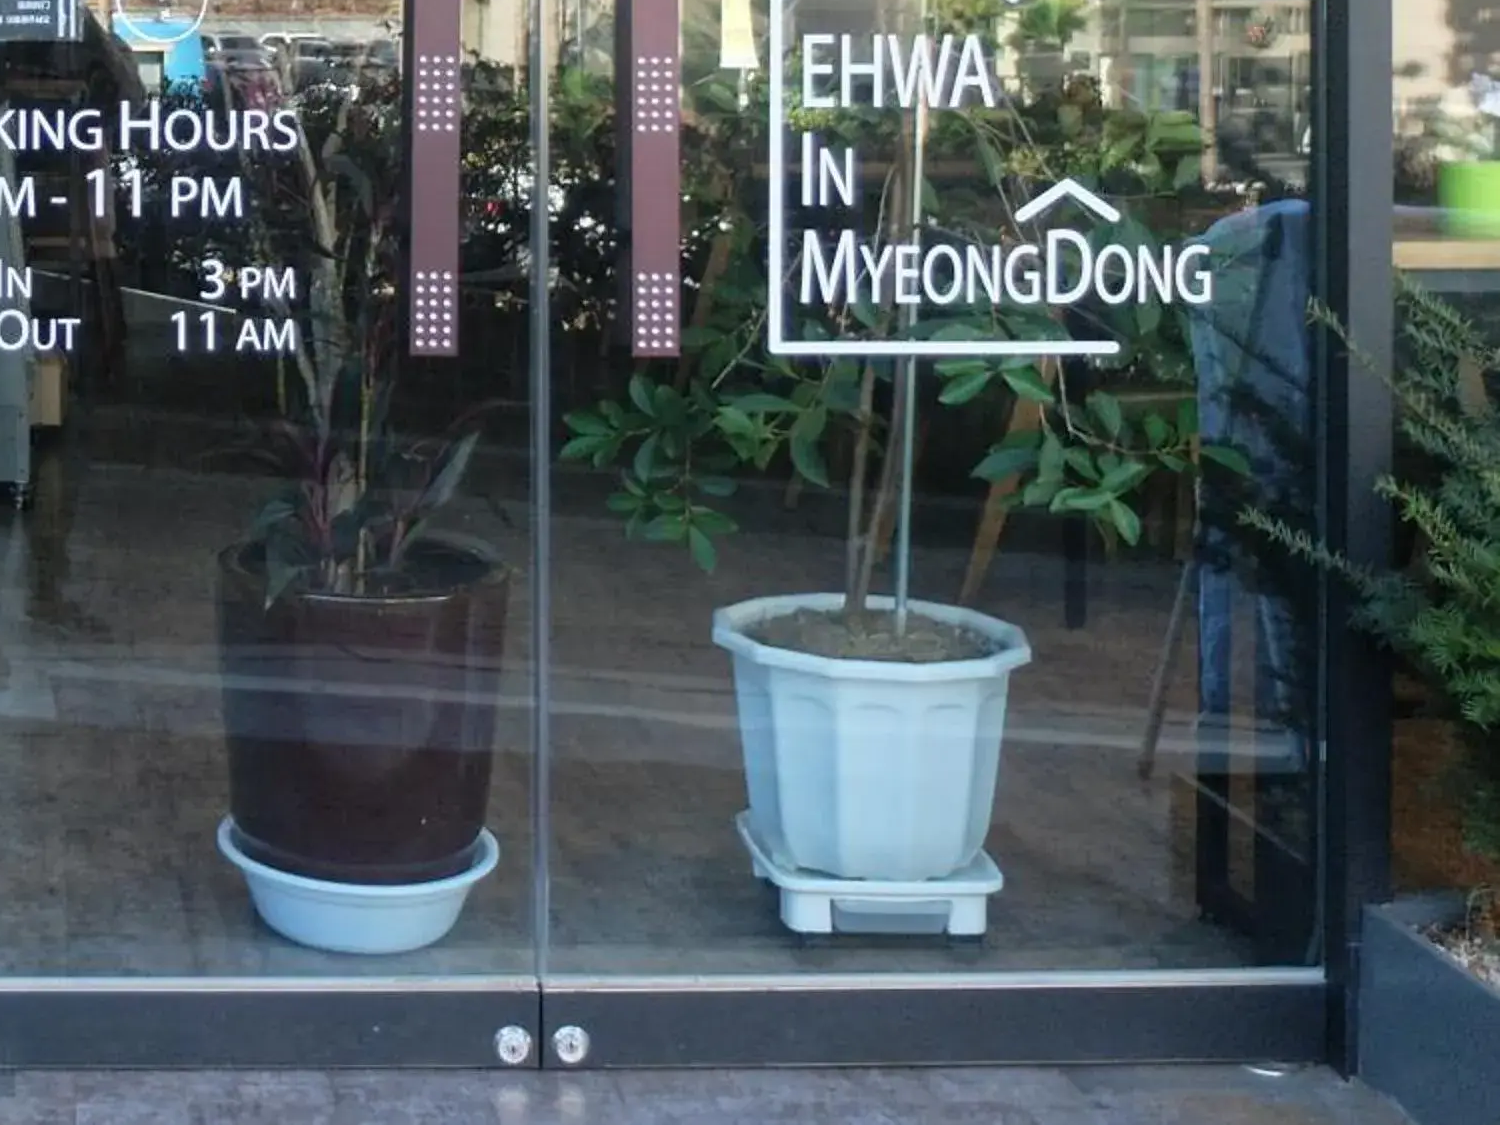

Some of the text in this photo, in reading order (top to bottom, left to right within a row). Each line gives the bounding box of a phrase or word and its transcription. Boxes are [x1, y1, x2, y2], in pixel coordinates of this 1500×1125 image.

[801, 33, 996, 109] EHWA
[119, 100, 298, 151] HOURS
[85, 167, 143, 218] 11
[170, 177, 244, 218] PM
[800, 131, 854, 207] IN
[199, 257, 226, 300] 3
[240, 265, 297, 300] PM
[170, 309, 217, 351] 11
[235, 316, 297, 351] AM
